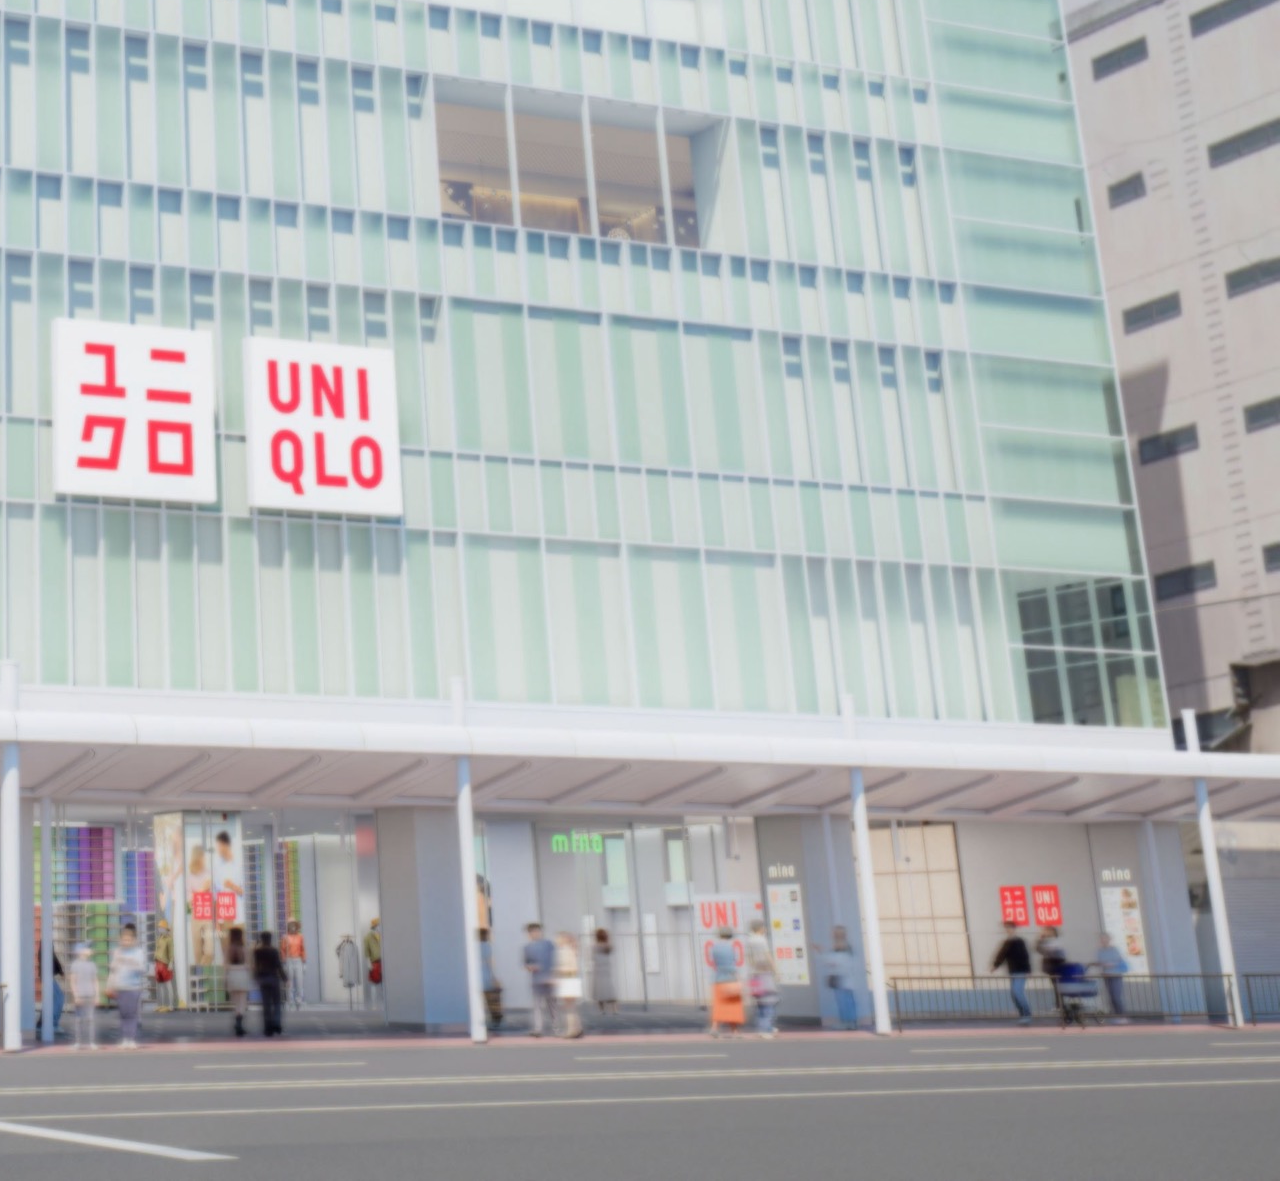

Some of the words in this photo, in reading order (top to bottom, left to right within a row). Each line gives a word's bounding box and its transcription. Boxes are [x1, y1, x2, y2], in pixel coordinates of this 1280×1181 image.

[80, 342, 192, 404] ユニ
[267, 359, 370, 421] UNI
[77, 415, 194, 476] クロ
[271, 429, 383, 495] QLO
[551, 828, 603, 853] mina
[768, 863, 795, 878] mina
[1102, 868, 1131, 881] mina
[1036, 890, 1055, 904] UNI
[701, 901, 738, 929] UNI
[1038, 907, 1058, 922] QLO
